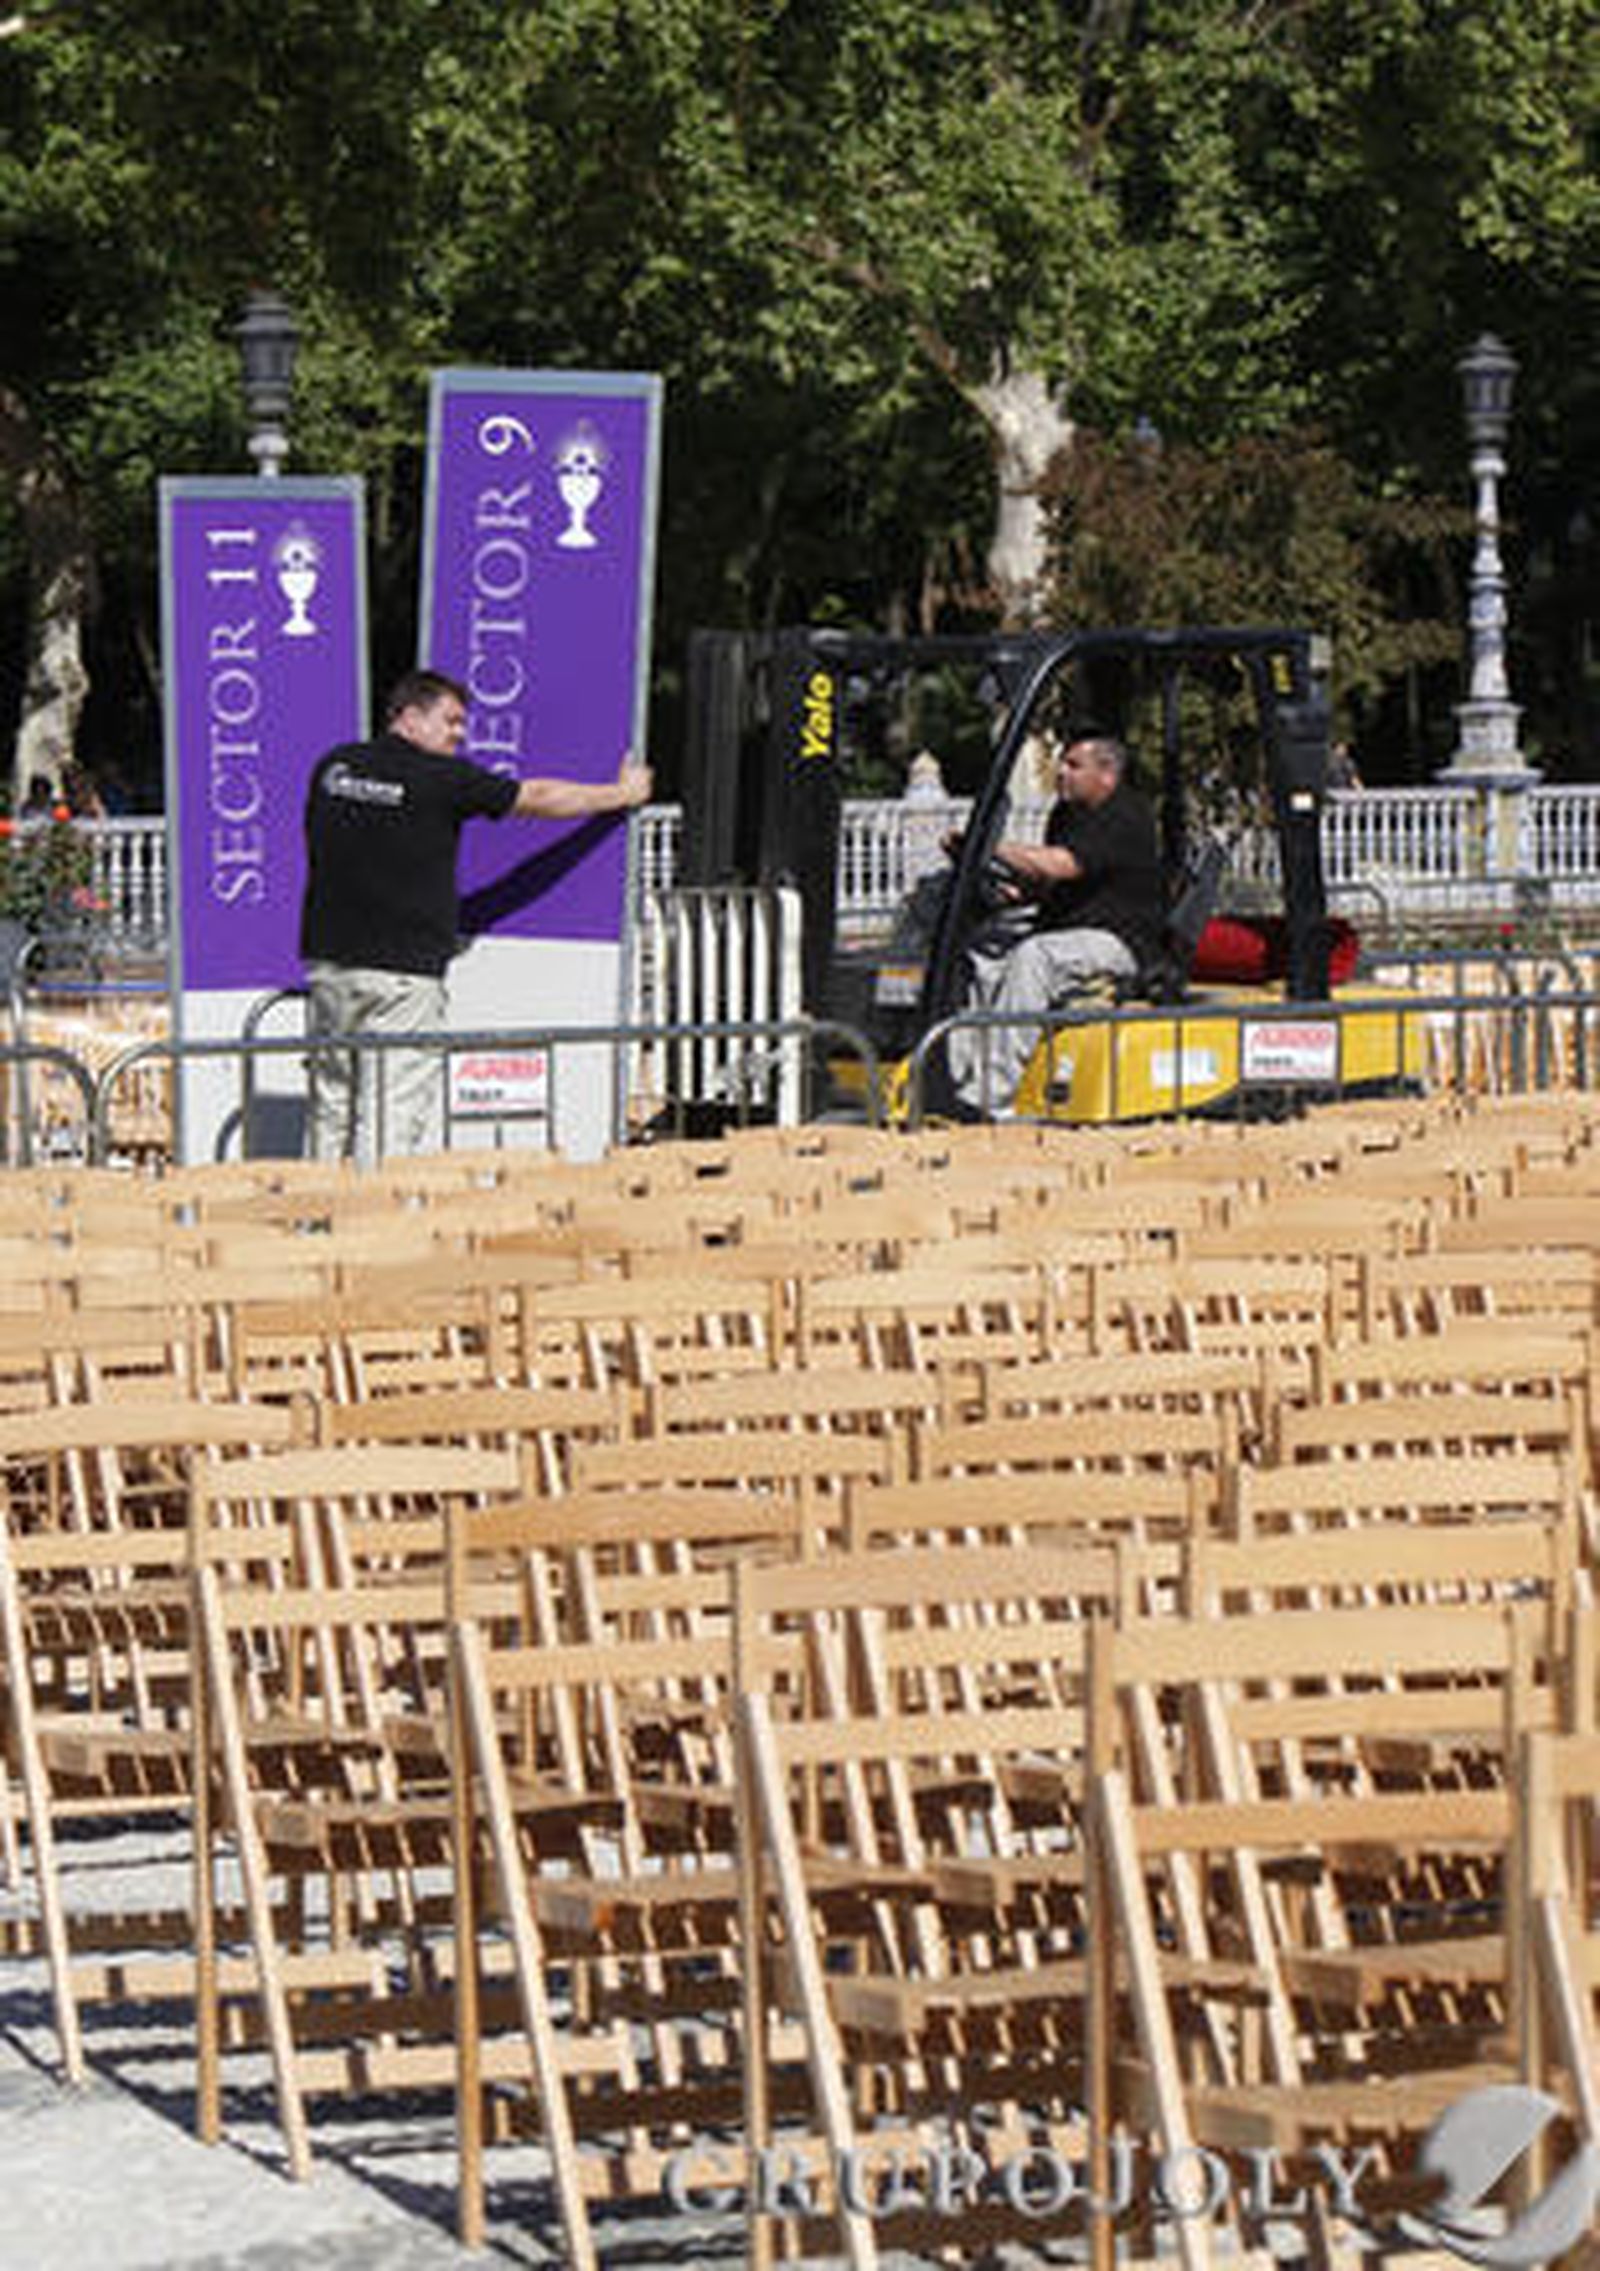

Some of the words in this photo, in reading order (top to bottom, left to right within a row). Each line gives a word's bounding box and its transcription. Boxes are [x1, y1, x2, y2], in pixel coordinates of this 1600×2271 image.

[478, 413, 535, 455] 9
[206, 526, 258, 586] 11
[209, 618, 266, 902] SECTOR
